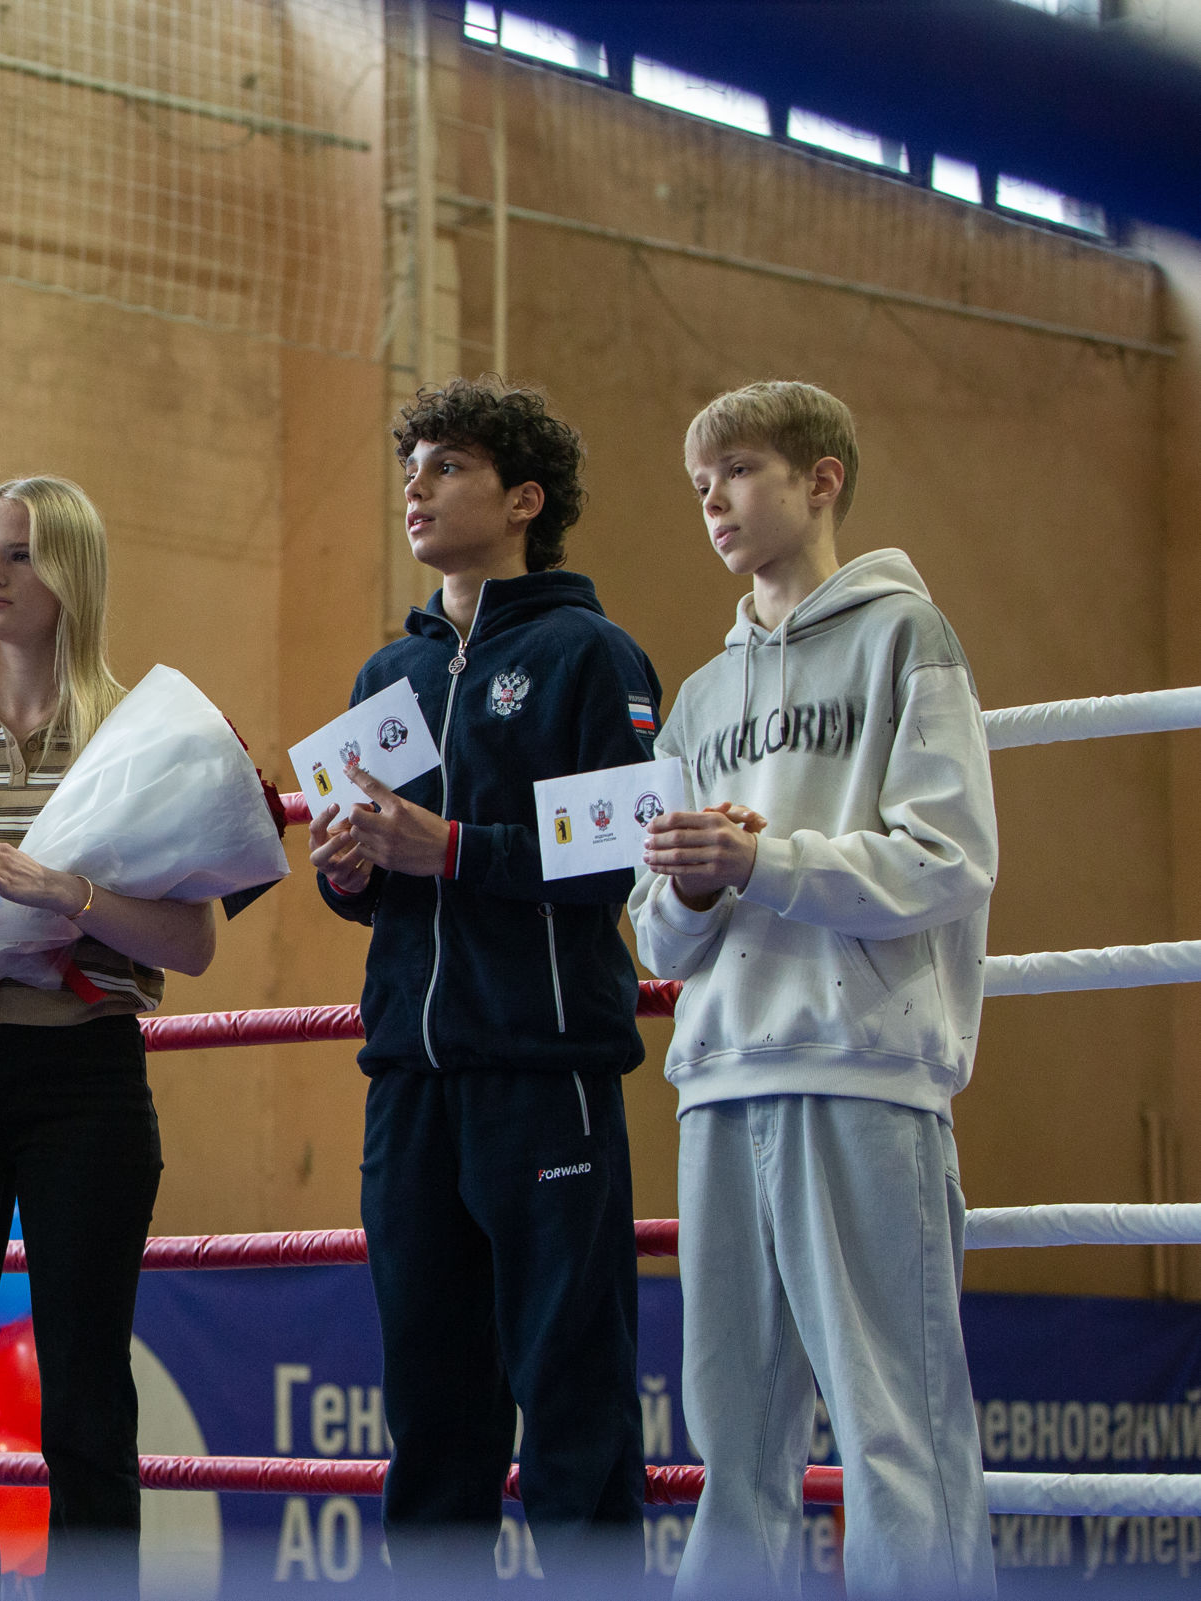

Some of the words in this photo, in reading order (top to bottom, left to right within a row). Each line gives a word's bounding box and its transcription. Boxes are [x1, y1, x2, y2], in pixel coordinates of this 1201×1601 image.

[538, 1162, 592, 1182] FORWARD
[974, 1388, 1201, 1461] евнований
[274, 1496, 362, 1583] АО
